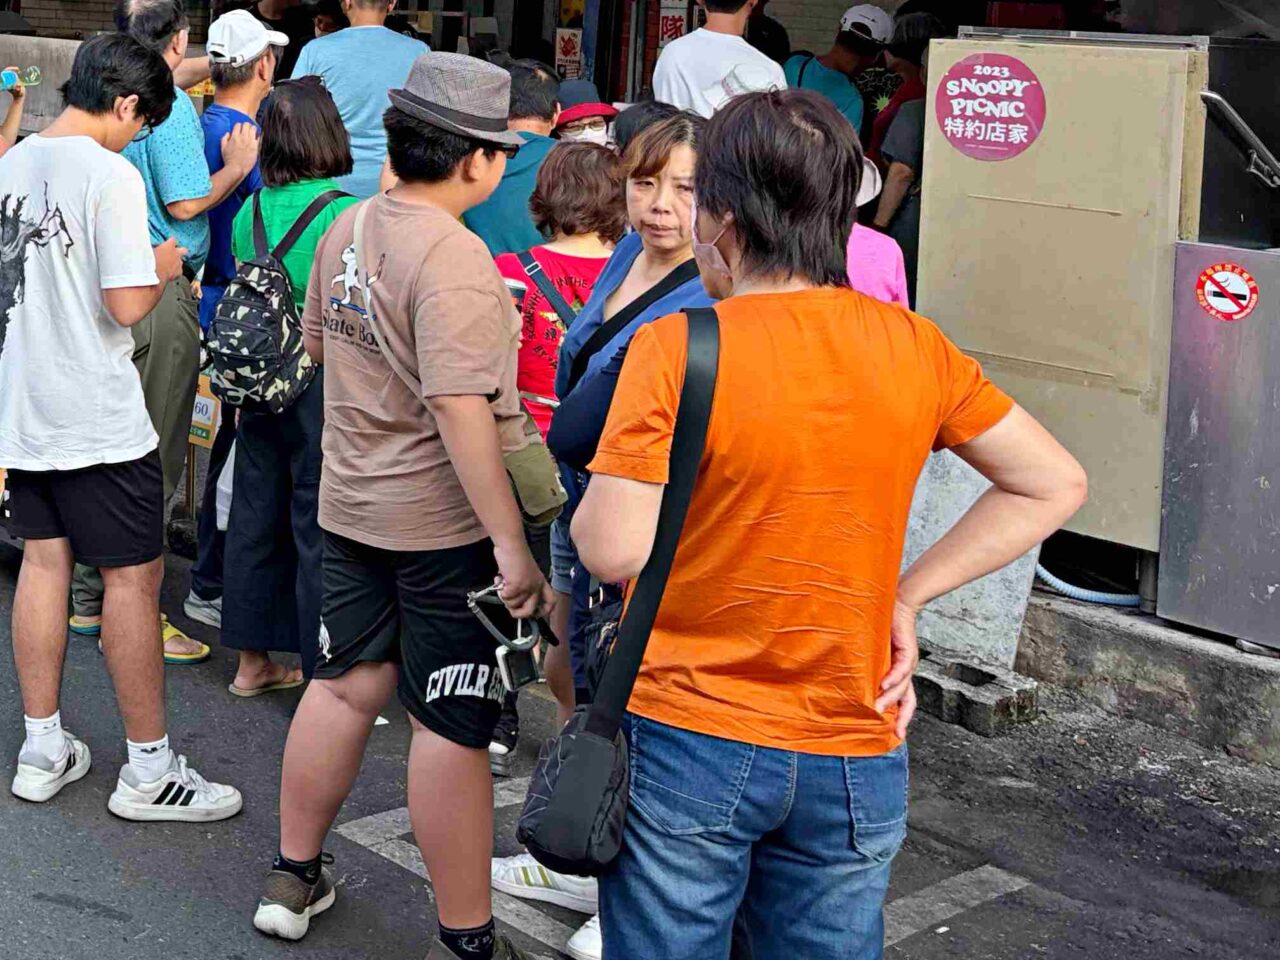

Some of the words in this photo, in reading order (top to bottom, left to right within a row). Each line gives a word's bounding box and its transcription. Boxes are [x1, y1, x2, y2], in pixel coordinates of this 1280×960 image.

[973, 65, 1010, 78] 2023
[946, 78, 1030, 97] SNOOPY
[950, 98, 1026, 118] PICNIC
[943, 116, 1029, 145] 特約店家
